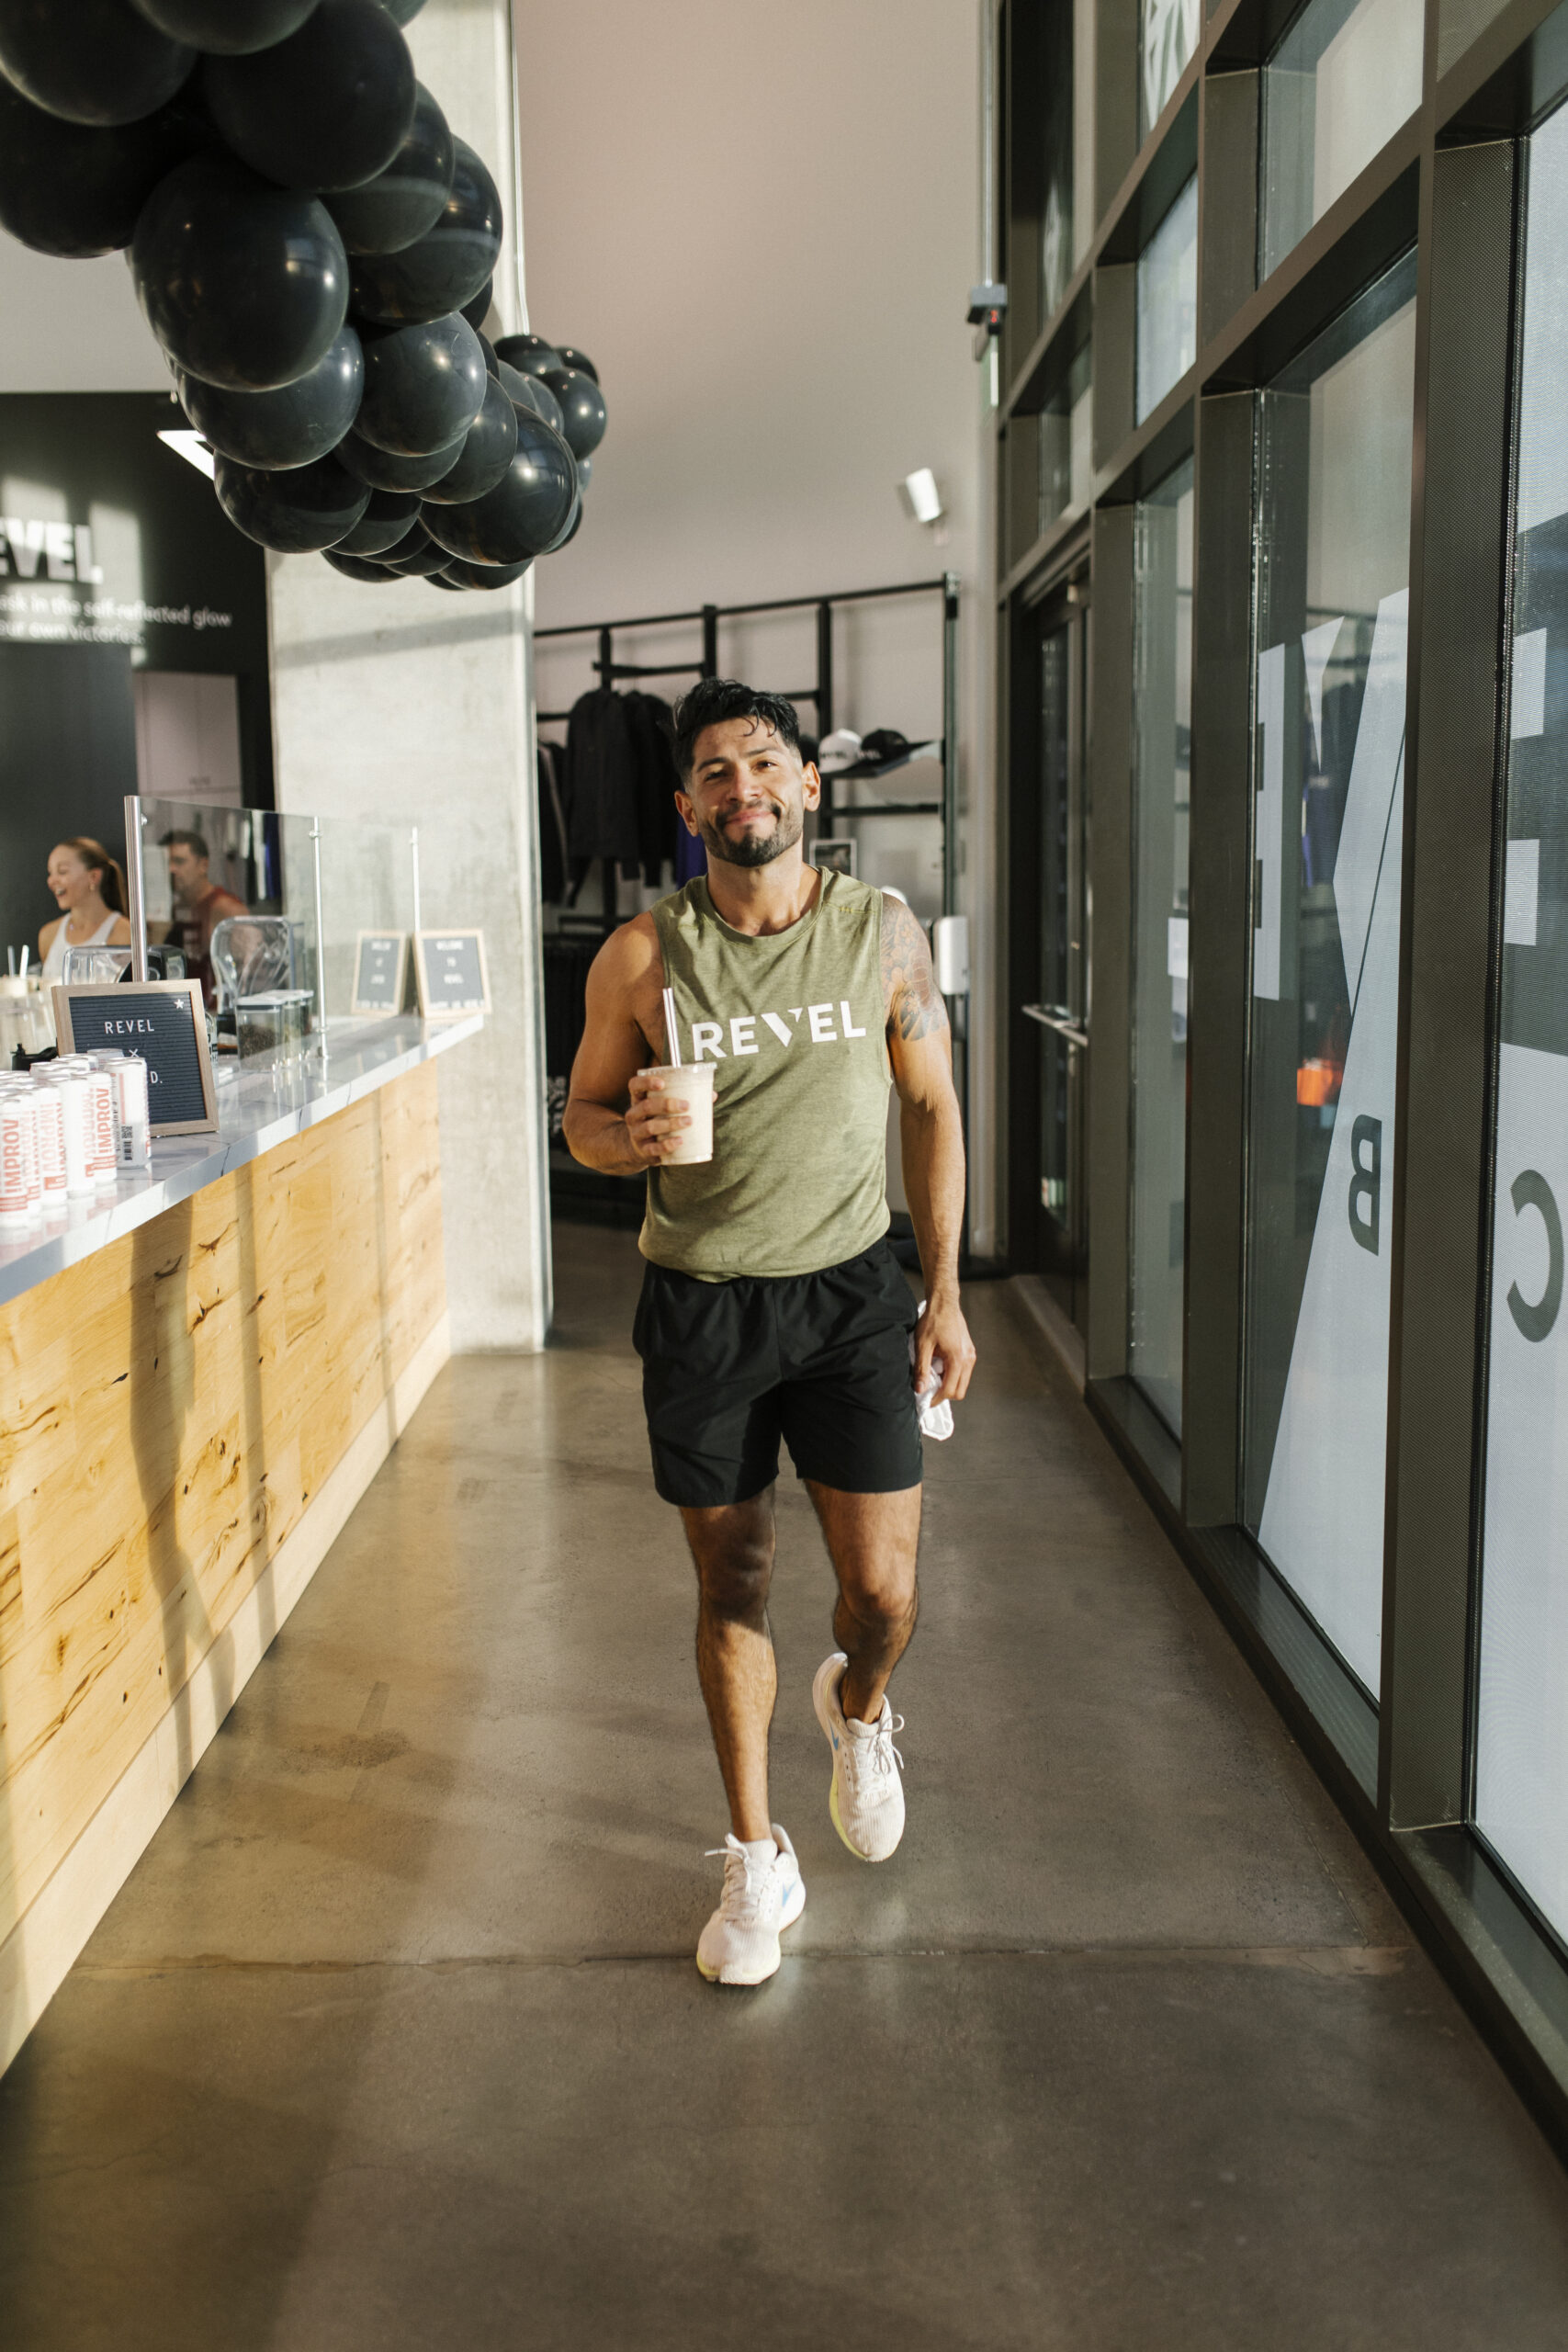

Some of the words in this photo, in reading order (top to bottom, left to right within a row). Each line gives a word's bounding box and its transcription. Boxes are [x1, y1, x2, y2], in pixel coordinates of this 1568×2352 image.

[193, 606, 231, 630] glow
[104, 1019, 154, 1035] REVEL
[692, 1001, 866, 1061] REVEL
